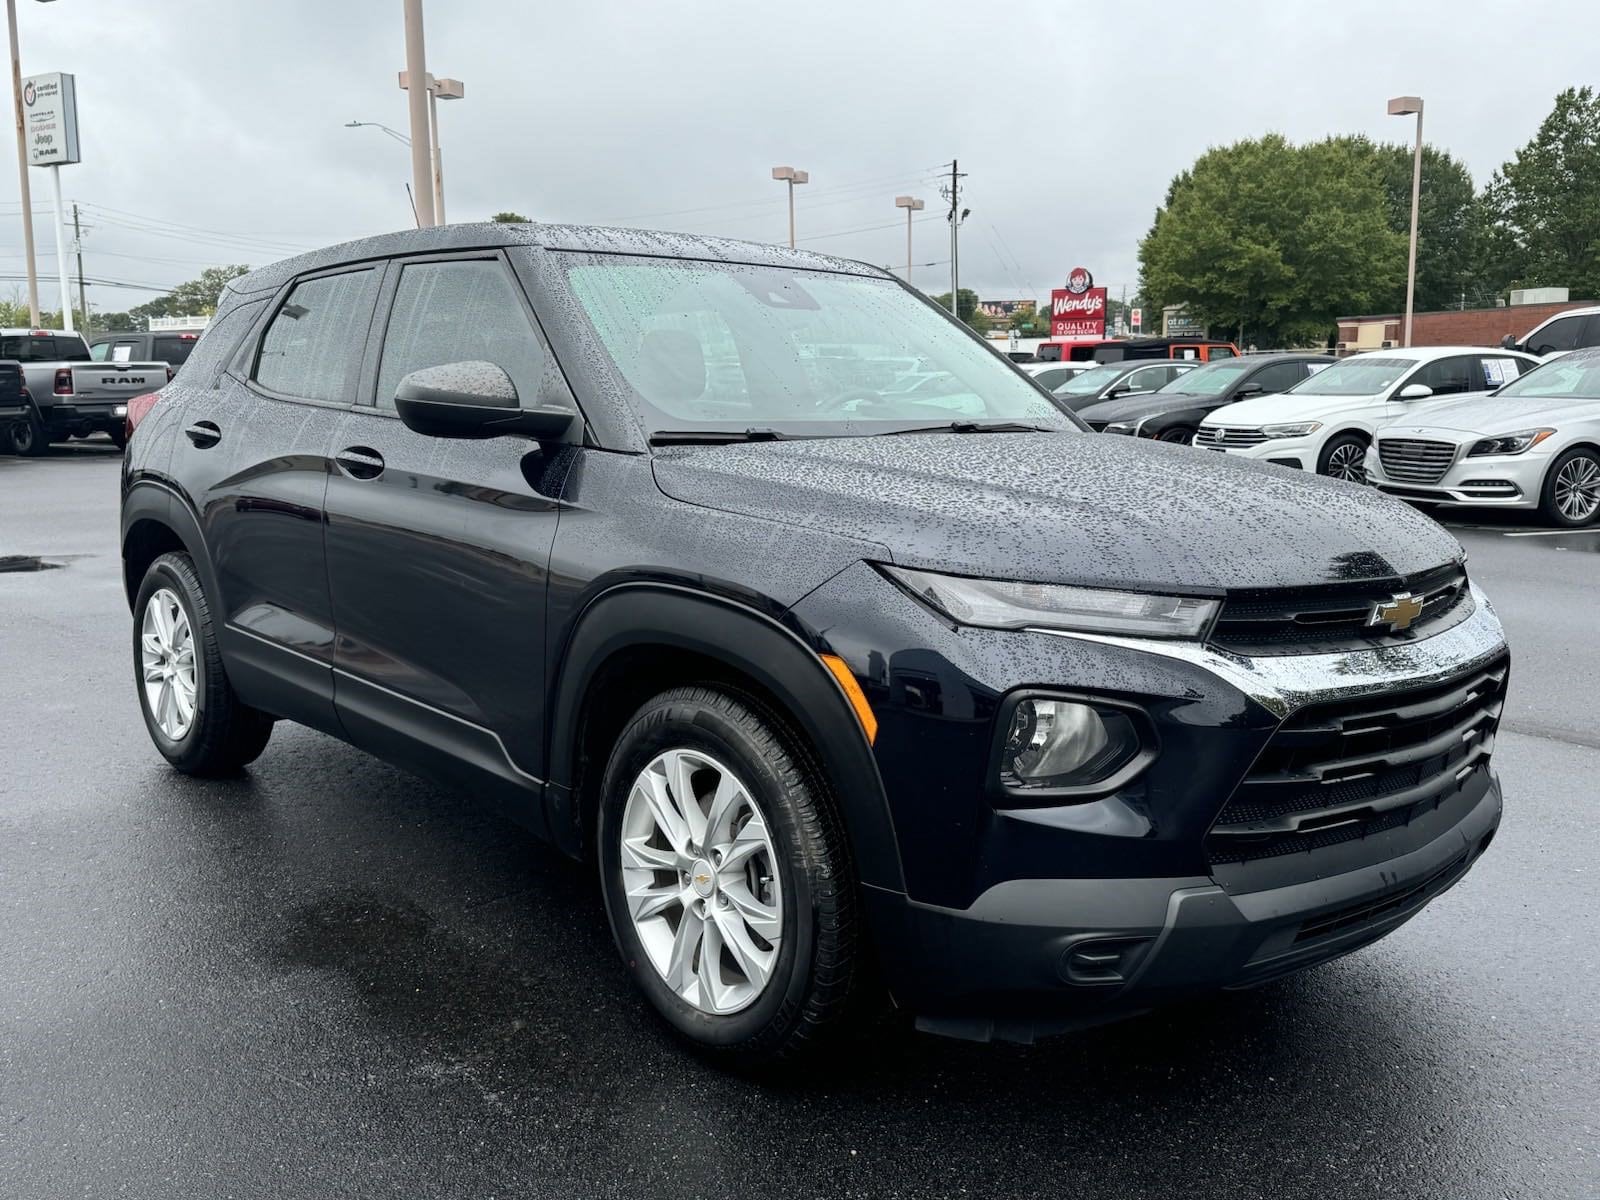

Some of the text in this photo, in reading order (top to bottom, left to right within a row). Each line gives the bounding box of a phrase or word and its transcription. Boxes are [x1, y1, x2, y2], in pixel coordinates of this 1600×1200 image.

[34, 133, 53, 145] Jeep
[1053, 293, 1103, 317] Wendy's
[1056, 321, 1098, 331] QUALITY
